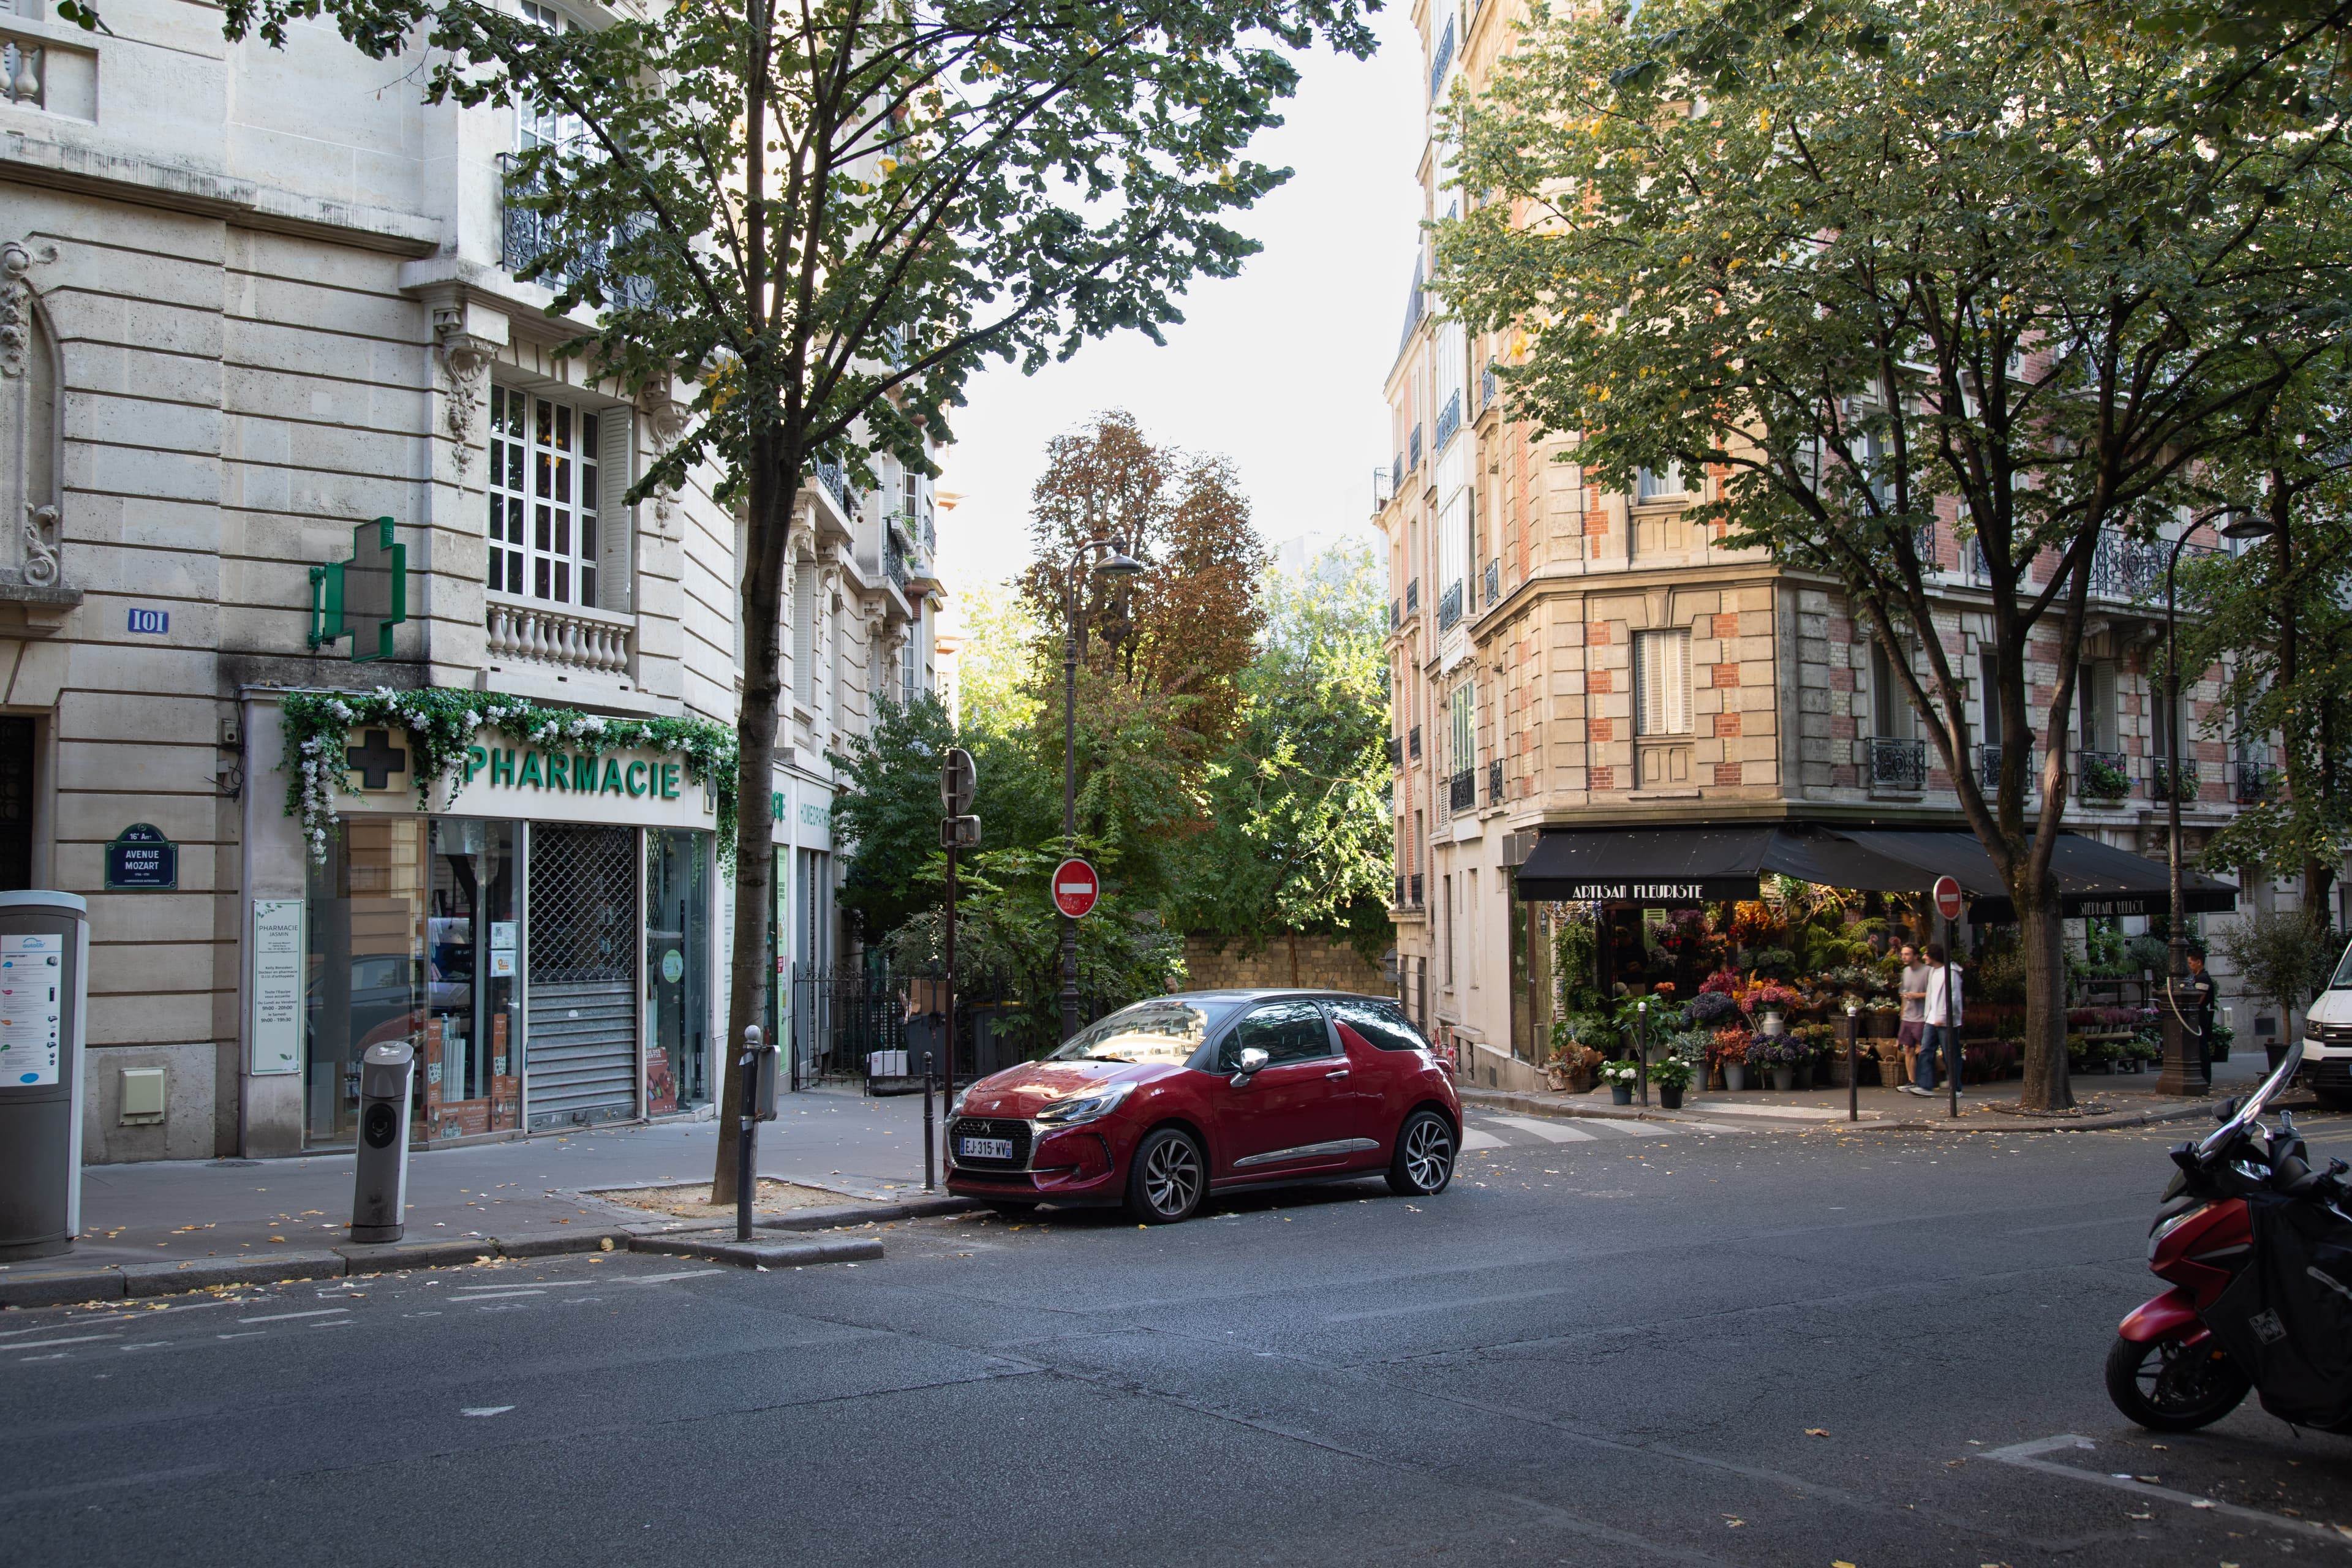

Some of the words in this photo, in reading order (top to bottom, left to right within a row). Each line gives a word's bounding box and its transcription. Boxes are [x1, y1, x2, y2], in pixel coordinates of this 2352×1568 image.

[133, 611, 164, 631] 101
[467, 745, 680, 797] PHARMACIE
[1572, 884, 1627, 899] ARTISAN
[1634, 884, 1703, 899] FLEURISTE
